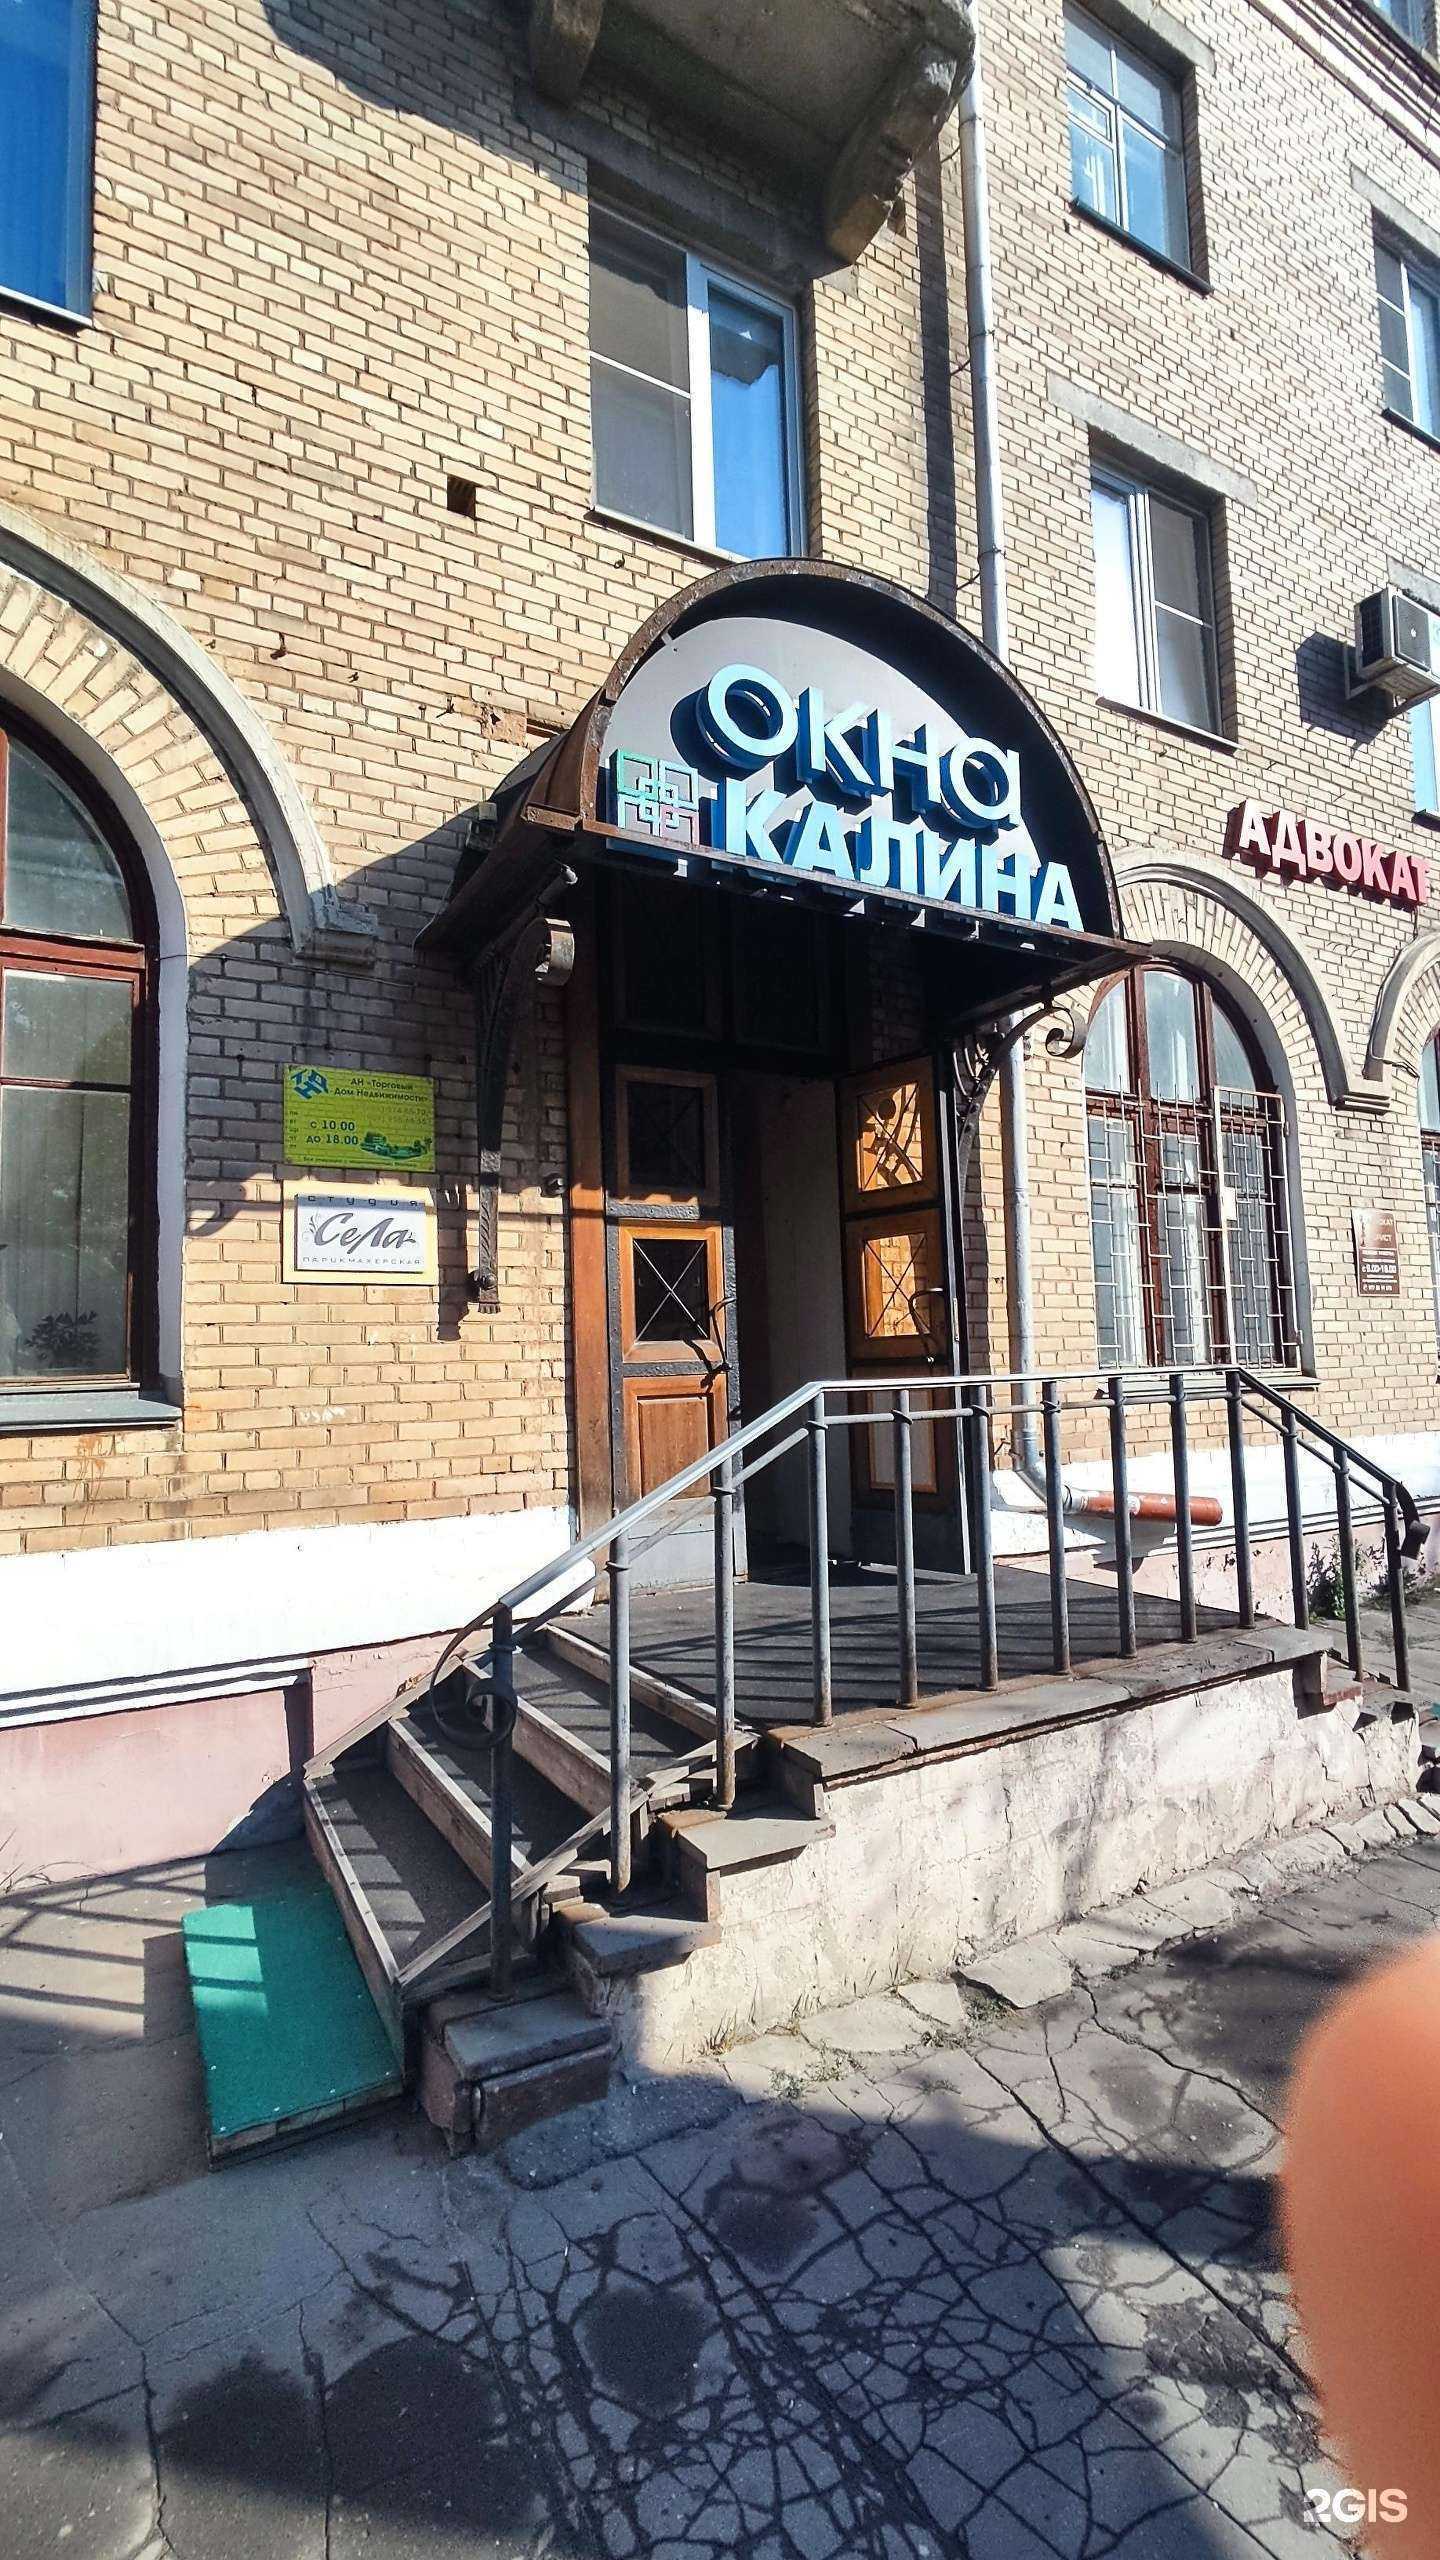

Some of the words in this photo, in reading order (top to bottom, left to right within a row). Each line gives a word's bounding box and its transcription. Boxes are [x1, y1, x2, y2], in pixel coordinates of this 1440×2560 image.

[724, 778, 1085, 933] КАЛИНА
[1238, 798, 1431, 904] АДВОКАТ
[334, 1087, 354, 1096] Дом
[326, 1133, 360, 1146] 18.00
